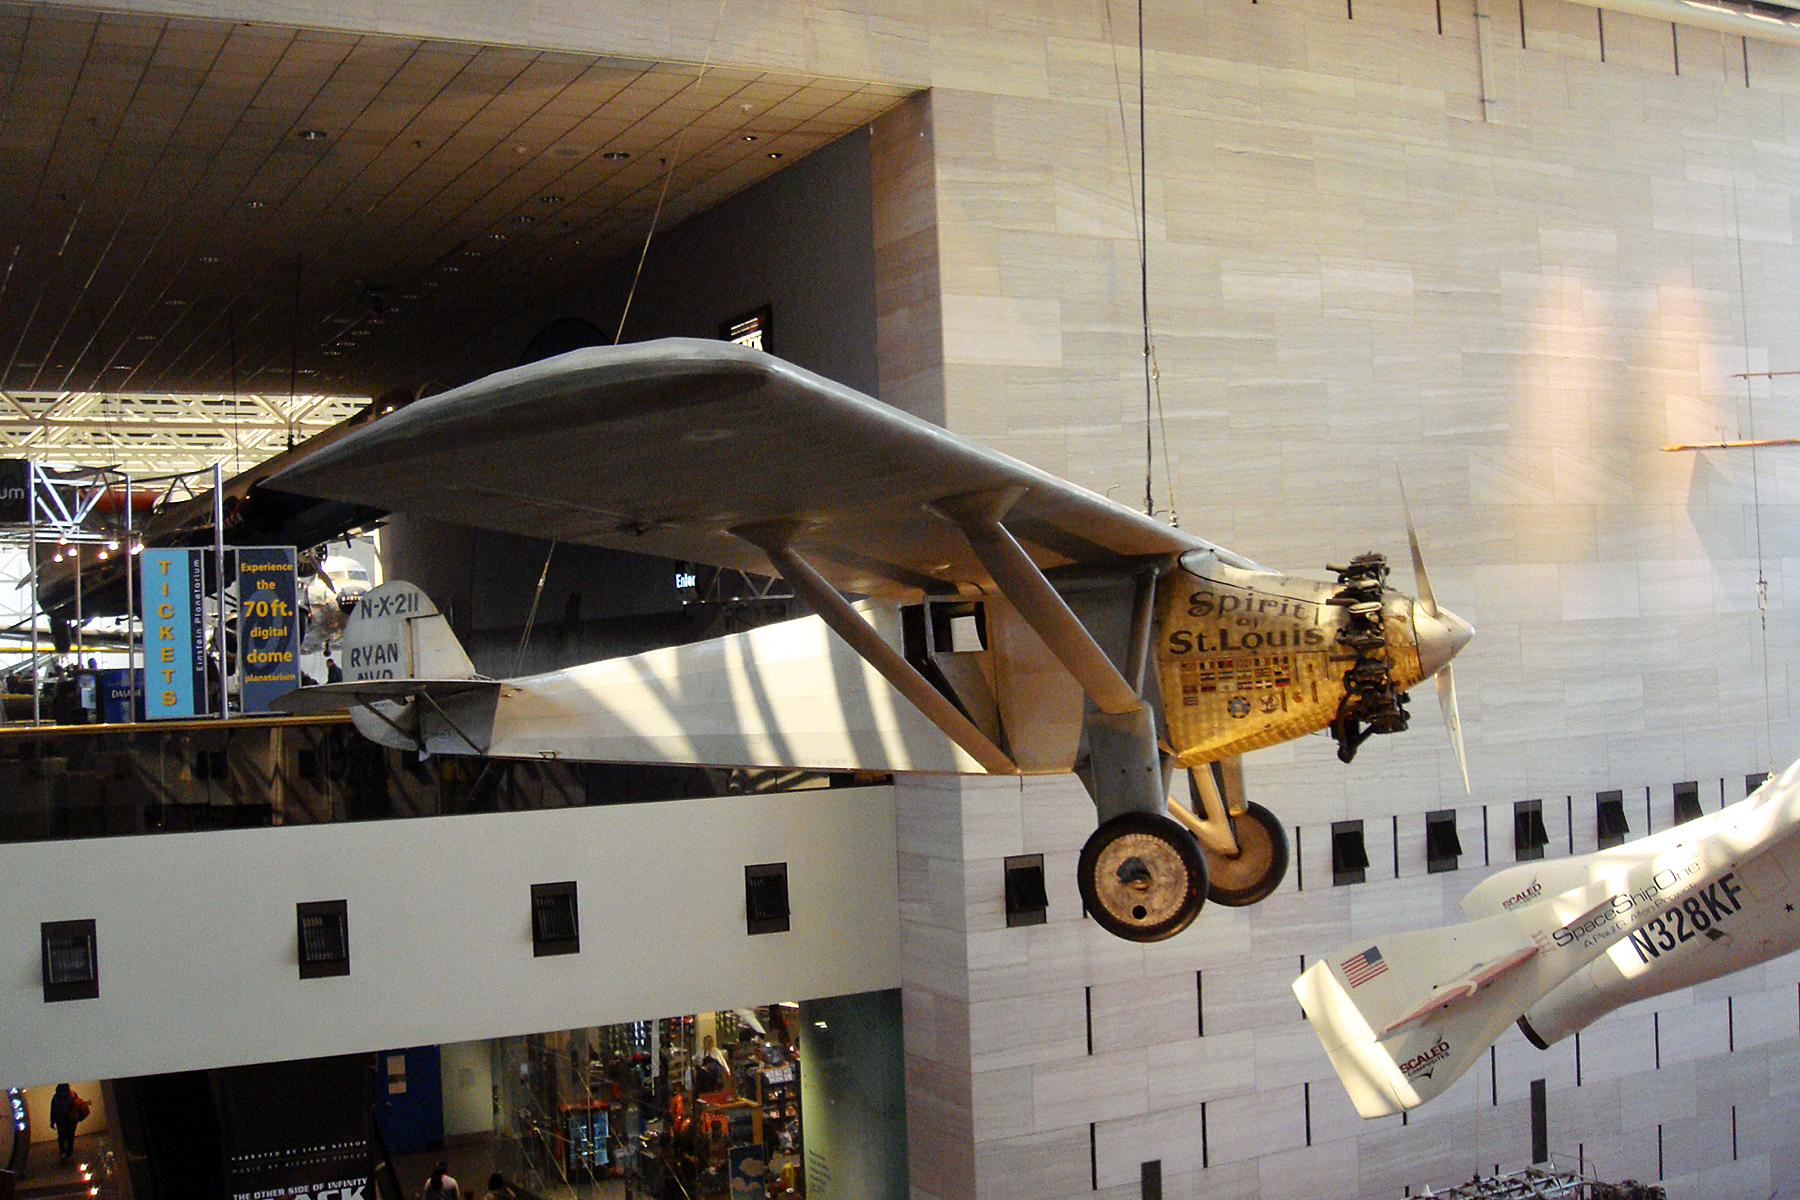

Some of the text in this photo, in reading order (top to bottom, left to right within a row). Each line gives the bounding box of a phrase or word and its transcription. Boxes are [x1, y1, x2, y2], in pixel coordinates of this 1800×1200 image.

[240, 562, 293, 574] Experience
[193, 559, 202, 624] Planetarium
[256, 579, 276, 590] the
[243, 599, 294, 618] 70 ft.
[361, 593, 419, 619] N-X-211
[1187, 591, 1309, 620] Spirit
[157, 560, 177, 706] TICKETS
[250, 626, 288, 640] digital
[246, 649, 293, 664] dome
[350, 643, 399, 668] RYAN
[244, 673, 297, 684] planetarium
[1552, 861, 1701, 948] SpaceShipOne
[1630, 872, 1742, 965] N328KF
[1399, 1041, 1450, 1074] SCALED
[254, 1187, 286, 1200] OTHER
[287, 1184, 310, 1195] SIDE
[312, 1182, 325, 1192] OF
[328, 1177, 369, 1190] INFINITY
